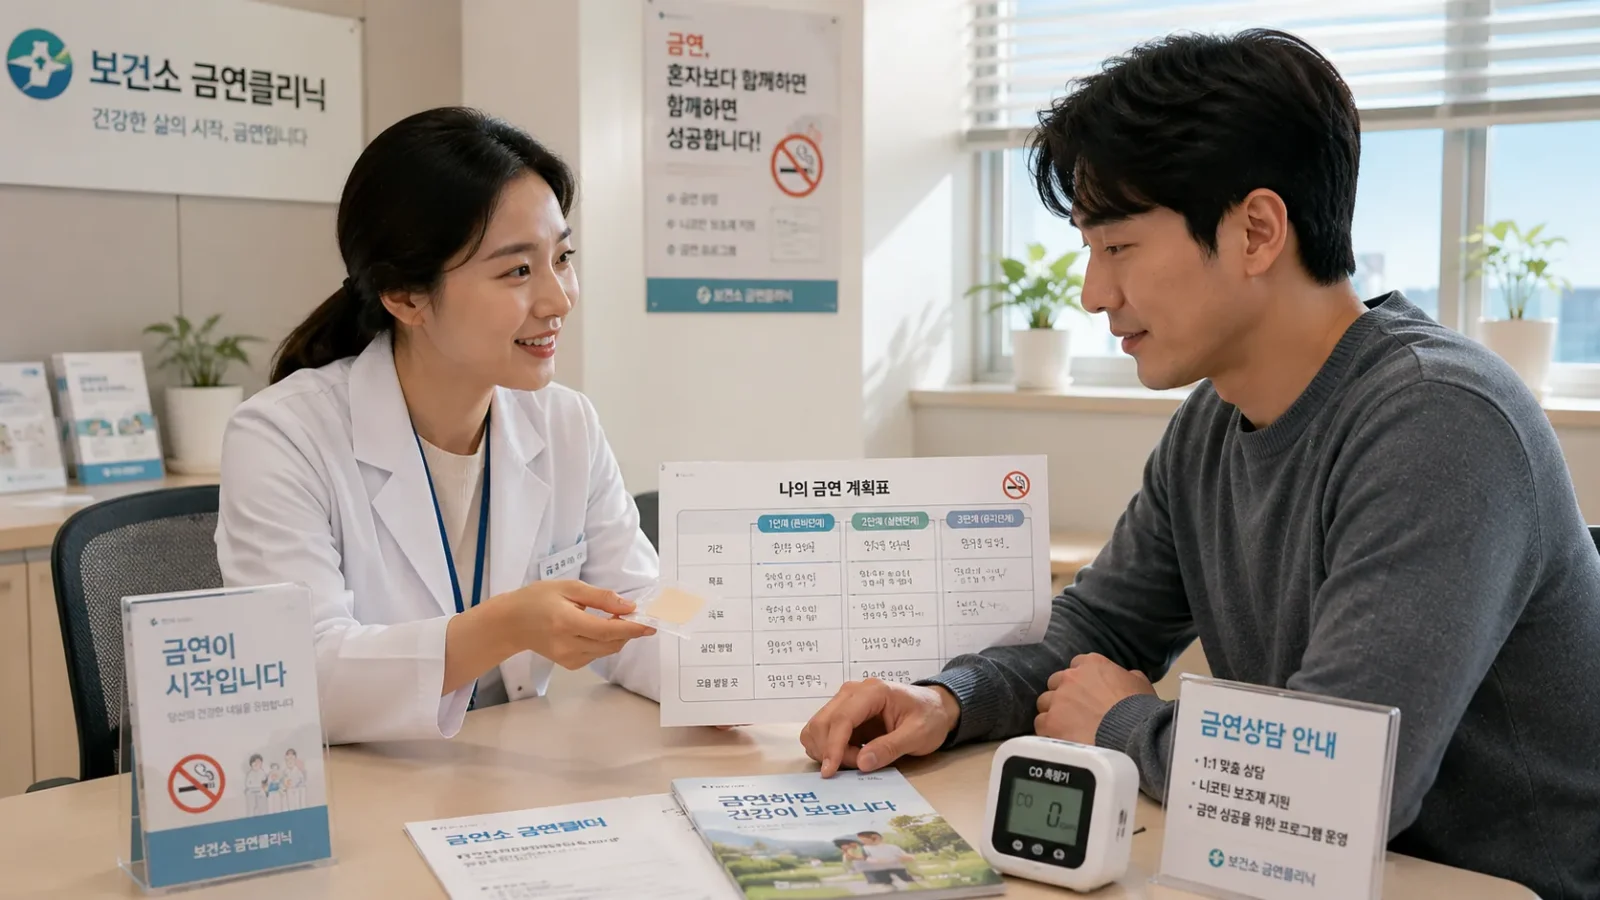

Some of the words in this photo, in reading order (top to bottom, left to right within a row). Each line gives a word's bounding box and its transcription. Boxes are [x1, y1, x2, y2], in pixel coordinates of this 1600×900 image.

[667, 32, 710, 58] 금연,
[90, 50, 181, 92] 보건소
[191, 62, 327, 112] 금연클리닉
[667, 63, 737, 90] 혼자보다
[741, 69, 807, 94] 함께하면
[667, 95, 738, 121] 함께하면
[92, 107, 146, 134] 건강한
[153, 114, 187, 137] 삶의
[192, 118, 229, 142] 시작,
[233, 122, 308, 147] 금연입니다
[667, 127, 761, 152] 성공합니다!
[779, 480, 808, 498] 나의
[812, 480, 841, 497] 금연
[846, 479, 890, 496] 계획표
[708, 544, 723, 554] 기간
[162, 632, 236, 667] 금연이
[165, 660, 287, 699] 시작입니다
[197, 706, 224, 720] 건강한
[1200, 709, 1287, 750] 금연상담
[1292, 726, 1338, 759] 안내
[1029, 765, 1043, 778] CO
[1203, 756, 1217, 770] 1:1
[1220, 758, 1240, 776] 맞춤
[1243, 763, 1265, 781] 상담
[718, 791, 820, 807] 금연하면
[1199, 779, 1231, 798] 니코틴
[1268, 793, 1290, 811] 지원
[728, 806, 799, 821] 건강이
[1046, 801, 1062, 828] 0
[193, 841, 231, 859] 보건소
[234, 830, 292, 853] 금연클리닉
[1254, 814, 1276, 832] 위한
[1278, 819, 1323, 842] 프로그램
[1325, 829, 1349, 848] 운영
[1228, 855, 1259, 873] 보건소
[1261, 861, 1316, 887] 금연클리닉
